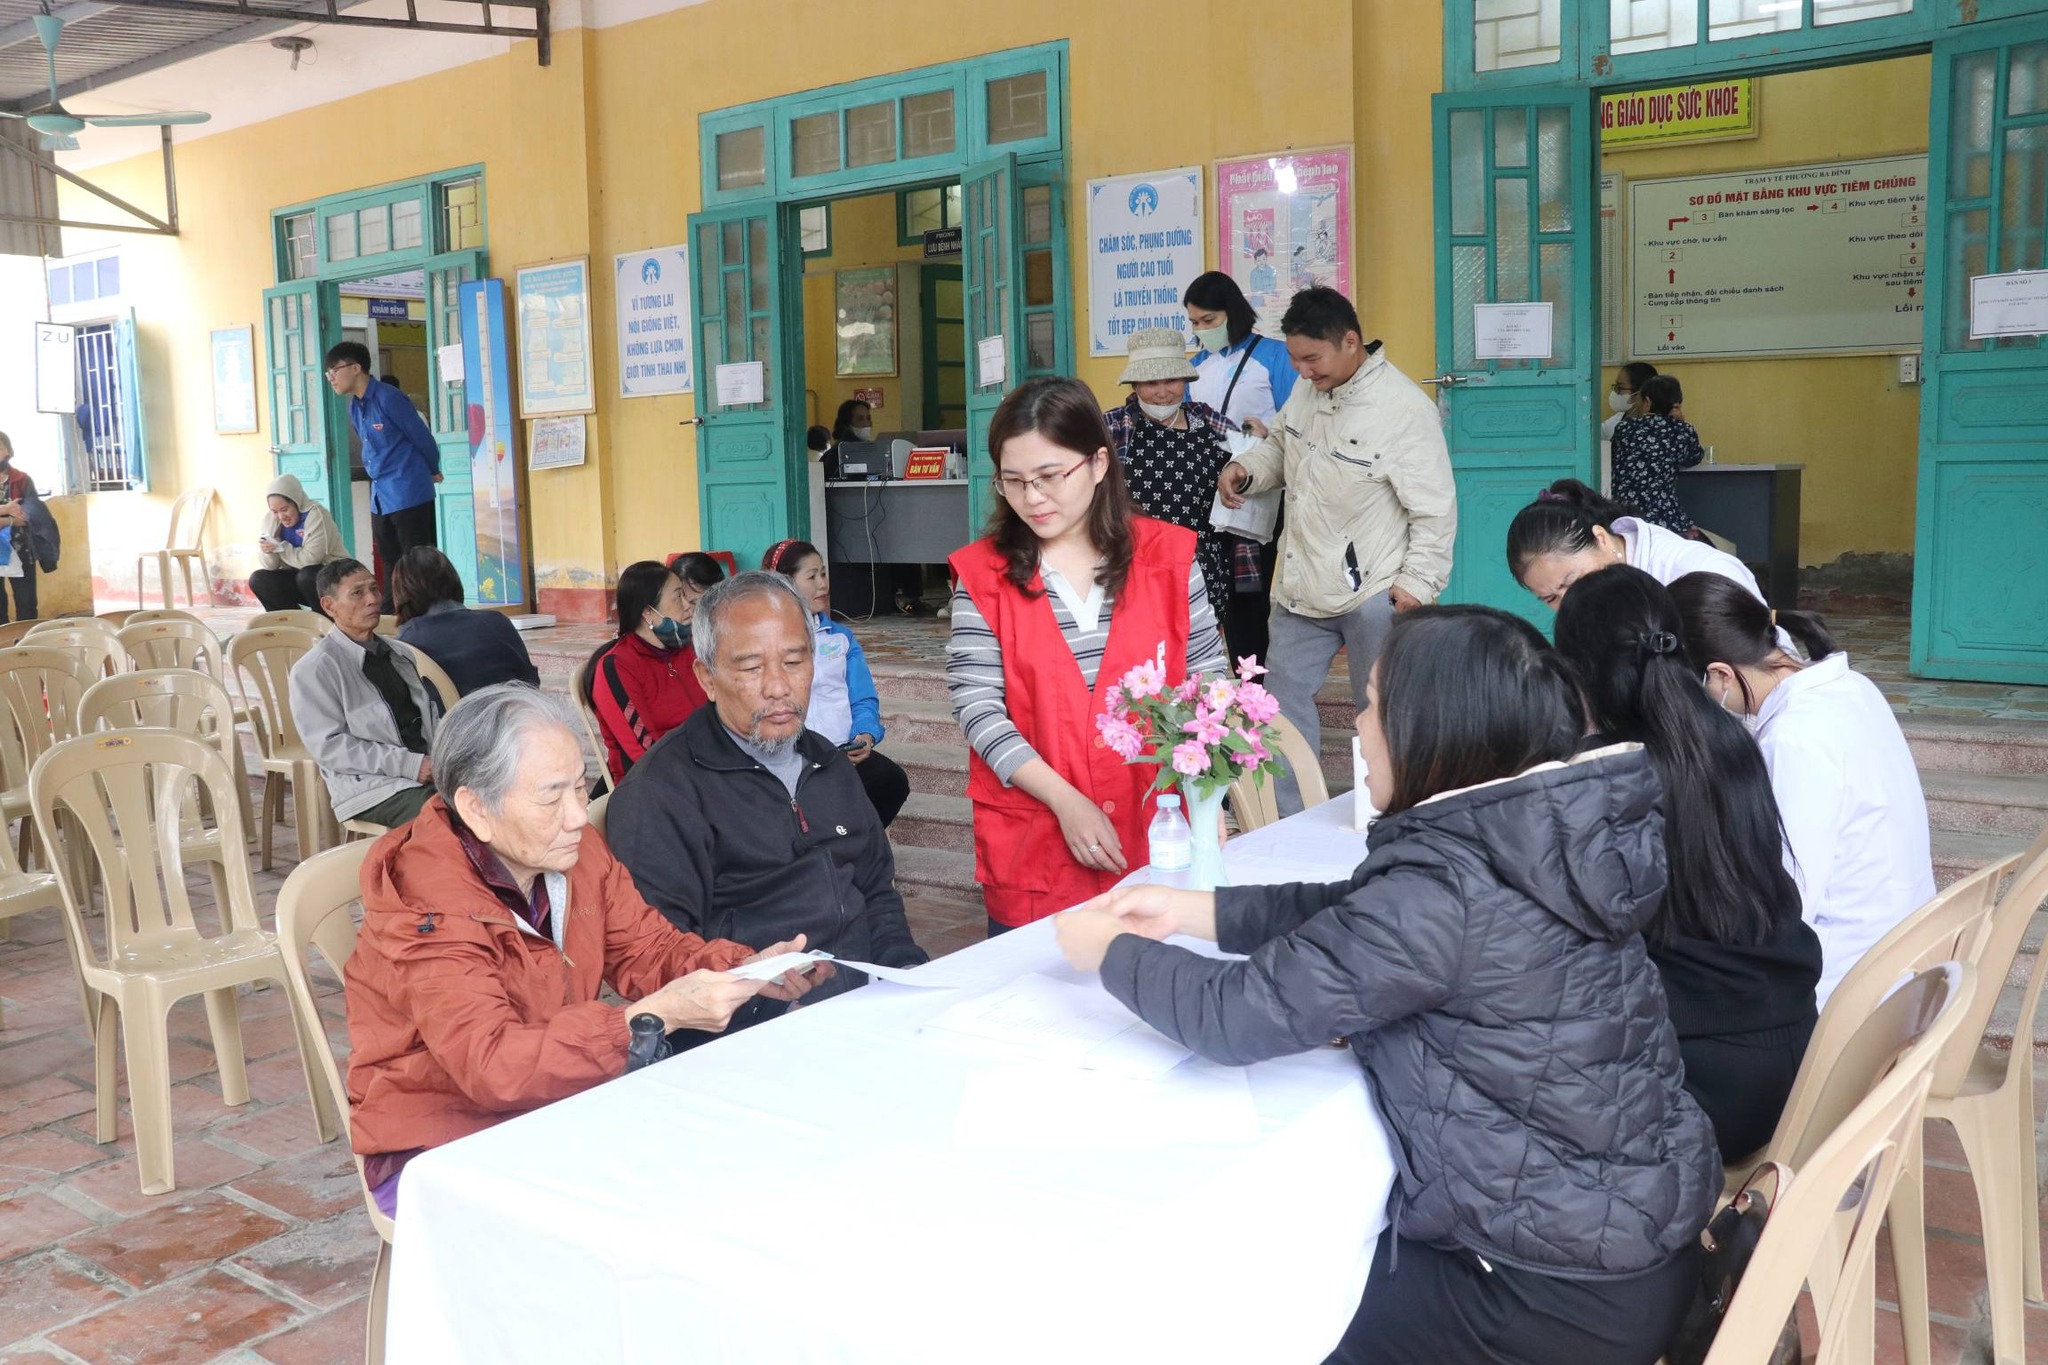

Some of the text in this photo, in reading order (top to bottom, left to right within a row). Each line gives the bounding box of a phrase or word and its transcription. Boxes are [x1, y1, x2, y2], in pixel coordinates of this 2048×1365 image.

[1600, 101, 1613, 129] NG
[1617, 92, 1645, 127] GIÁO
[1649, 93, 1673, 129] DỤC
[1677, 85, 1702, 121] SỨC
[1689, 195, 1705, 206] SƠ
[1725, 190, 1749, 204] MẶT
[1752, 187, 1784, 201] BẰNG
[1787, 186, 1811, 198] KHU
[1815, 183, 1838, 197] VỰC
[1841, 179, 1870, 193] TIÊM
[1874, 175, 1916, 190] CHỦNG
[1831, 202, 1838, 210] 4
[1849, 199, 1866, 207] Khu
[1701, 213, 1708, 221] 3
[1911, 215, 1919, 224] 5
[1121, 231, 1138, 252] SÓC,
[1139, 232, 1164, 253] PHỤNG
[1848, 235, 1866, 243] Khu
[1887, 232, 1907, 240] theo
[951, 238, 962, 251] NHÂ
[1669, 251, 1676, 260] 2
[1909, 256, 1917, 265] 6
[1140, 260, 1155, 277] CAO
[1853, 273, 1870, 281] Khu
[1742, 286, 1763, 294] danh
[663, 293, 674, 307] LAI
[1648, 299, 1669, 307] Cung
[627, 340, 649, 356] KHÔNG
[664, 338, 684, 355] CHỌN
[657, 361, 672, 376] THAI
[674, 360, 687, 374] NHI
